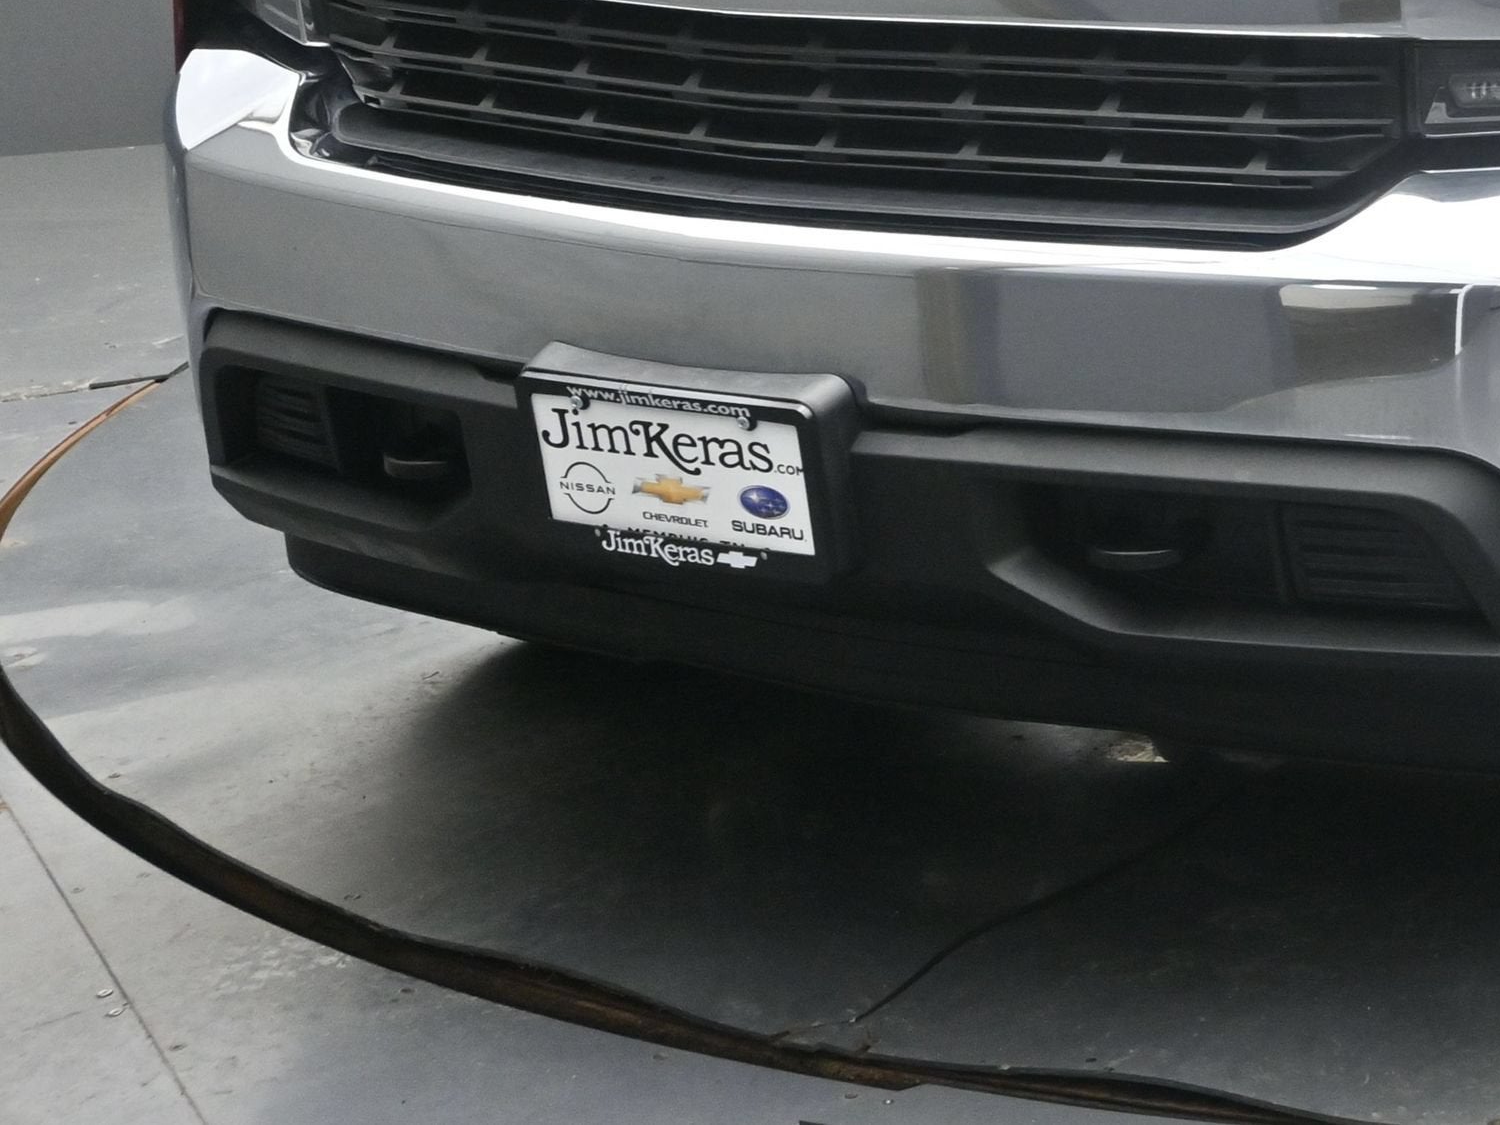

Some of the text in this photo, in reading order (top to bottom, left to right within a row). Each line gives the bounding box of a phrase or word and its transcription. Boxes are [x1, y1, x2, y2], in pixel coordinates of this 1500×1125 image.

[567, 385, 750, 418] www.jimkeras.com
[559, 480, 616, 496] NISSAN
[642, 511, 708, 529] CHEVROLET
[731, 520, 805, 541] SUBARU
